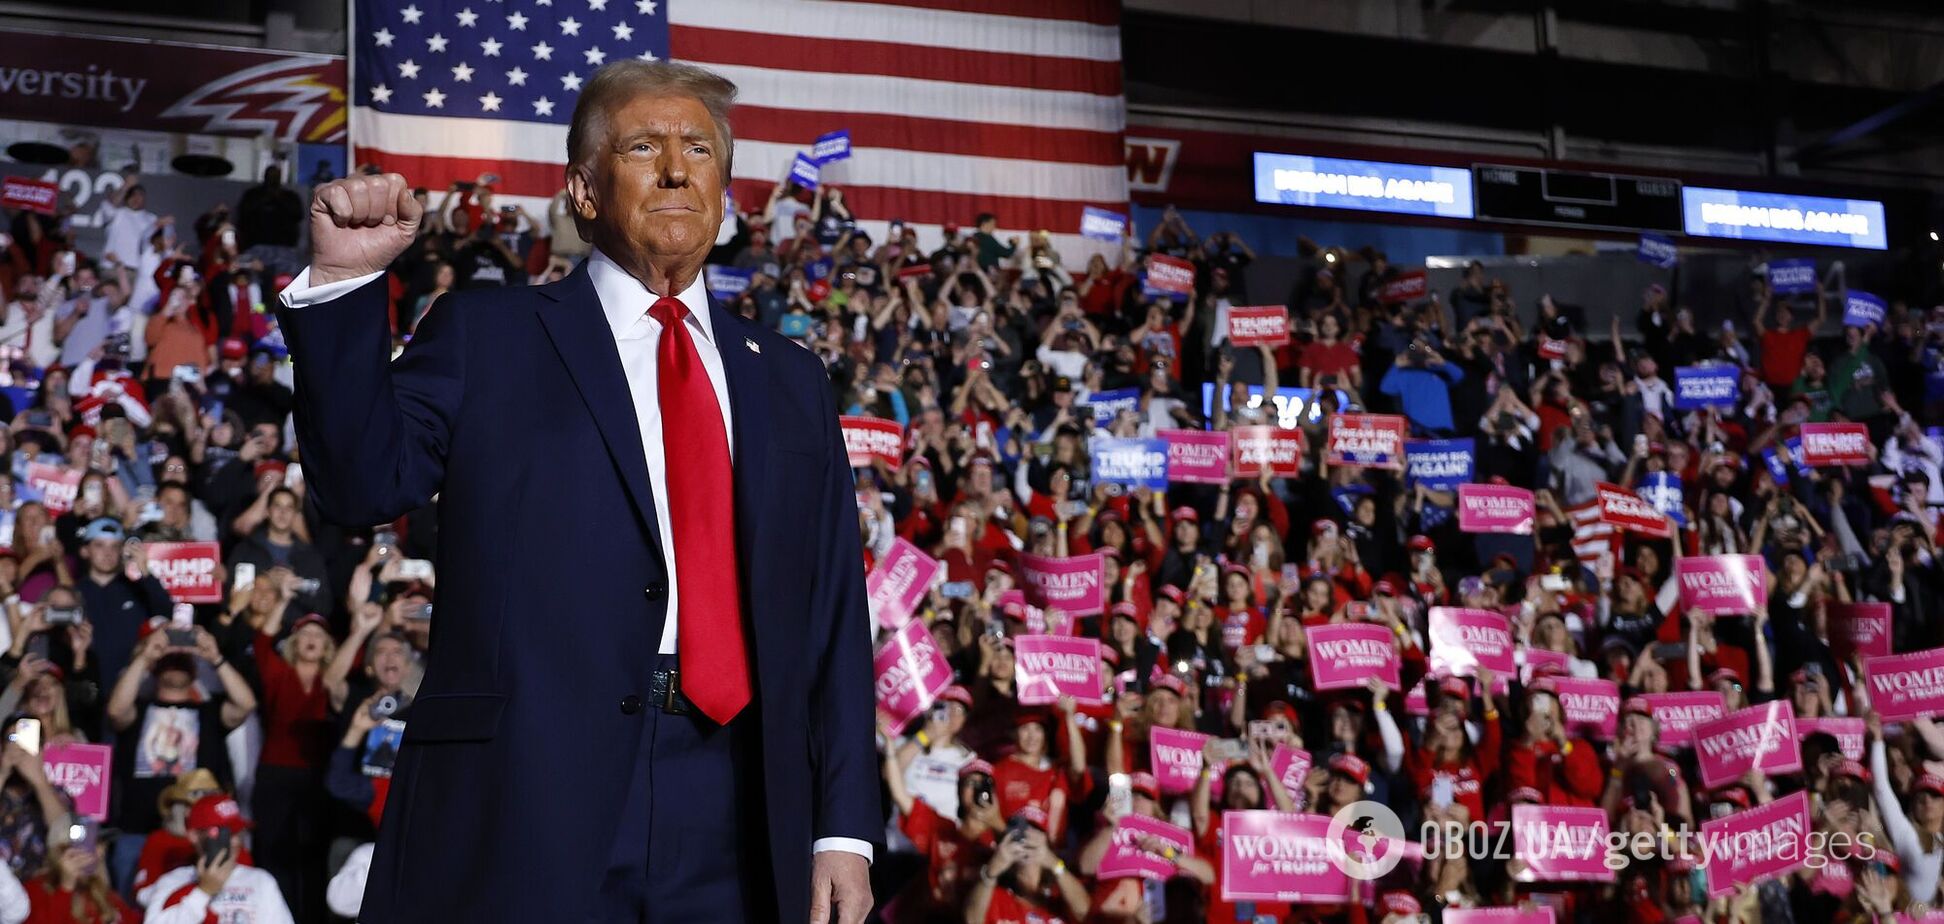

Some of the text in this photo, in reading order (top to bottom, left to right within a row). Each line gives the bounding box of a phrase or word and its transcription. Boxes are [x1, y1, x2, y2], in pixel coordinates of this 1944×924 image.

[0, 66, 147, 112] versity
[1231, 317, 1285, 329] TRUMP
[1333, 428, 1372, 440] DREAM
[1334, 438, 1396, 454] AGAIN!
[1097, 450, 1165, 467] TRUMP
[1239, 449, 1295, 464] AGAIN!
[1410, 462, 1470, 477] AGAIN!
[1466, 496, 1530, 512] WOMEN
[147, 558, 215, 577] RUMP
[1683, 571, 1760, 589] WOMN
[1459, 625, 1510, 649] OMEN
[1315, 639, 1393, 661] WOMEN
[877, 637, 936, 702] OMEN
[1022, 651, 1097, 675] WOMEN
[1559, 693, 1620, 714] OMEN
[1701, 719, 1791, 758] WOMEN
[44, 762, 104, 787] MEN
[1233, 835, 1345, 861] WOMEN
[1251, 861, 1329, 877] for TRUMP
